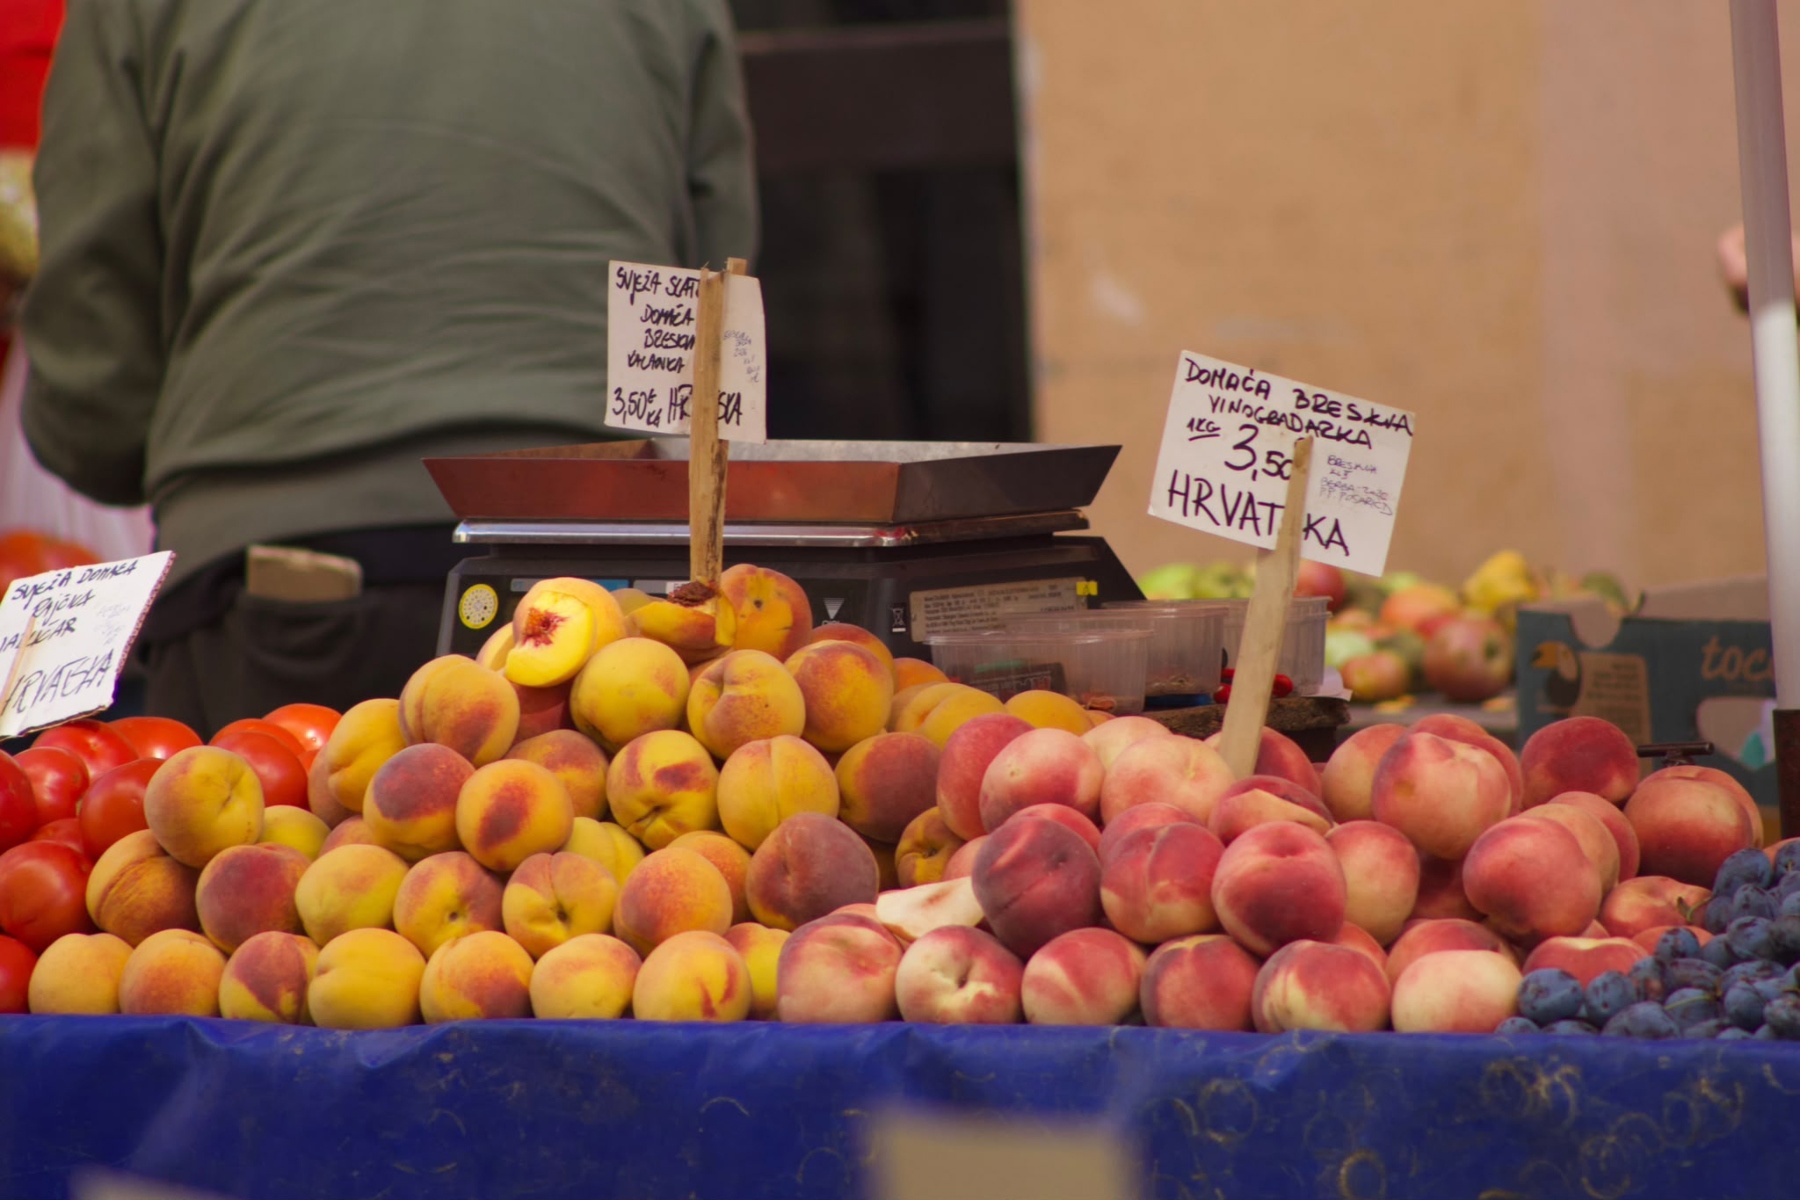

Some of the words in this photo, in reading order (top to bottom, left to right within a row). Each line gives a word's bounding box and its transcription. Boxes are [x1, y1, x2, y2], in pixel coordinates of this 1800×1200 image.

[640, 304, 695, 327] DOMAĆA
[1185, 357, 1271, 400] DOMAĆA
[1292, 388, 1413, 437] BRESKVA
[1208, 394, 1373, 450] VINOGRADARKA
[1168, 469, 1350, 557] HRVATKA
[1701, 635, 1775, 682] toc
